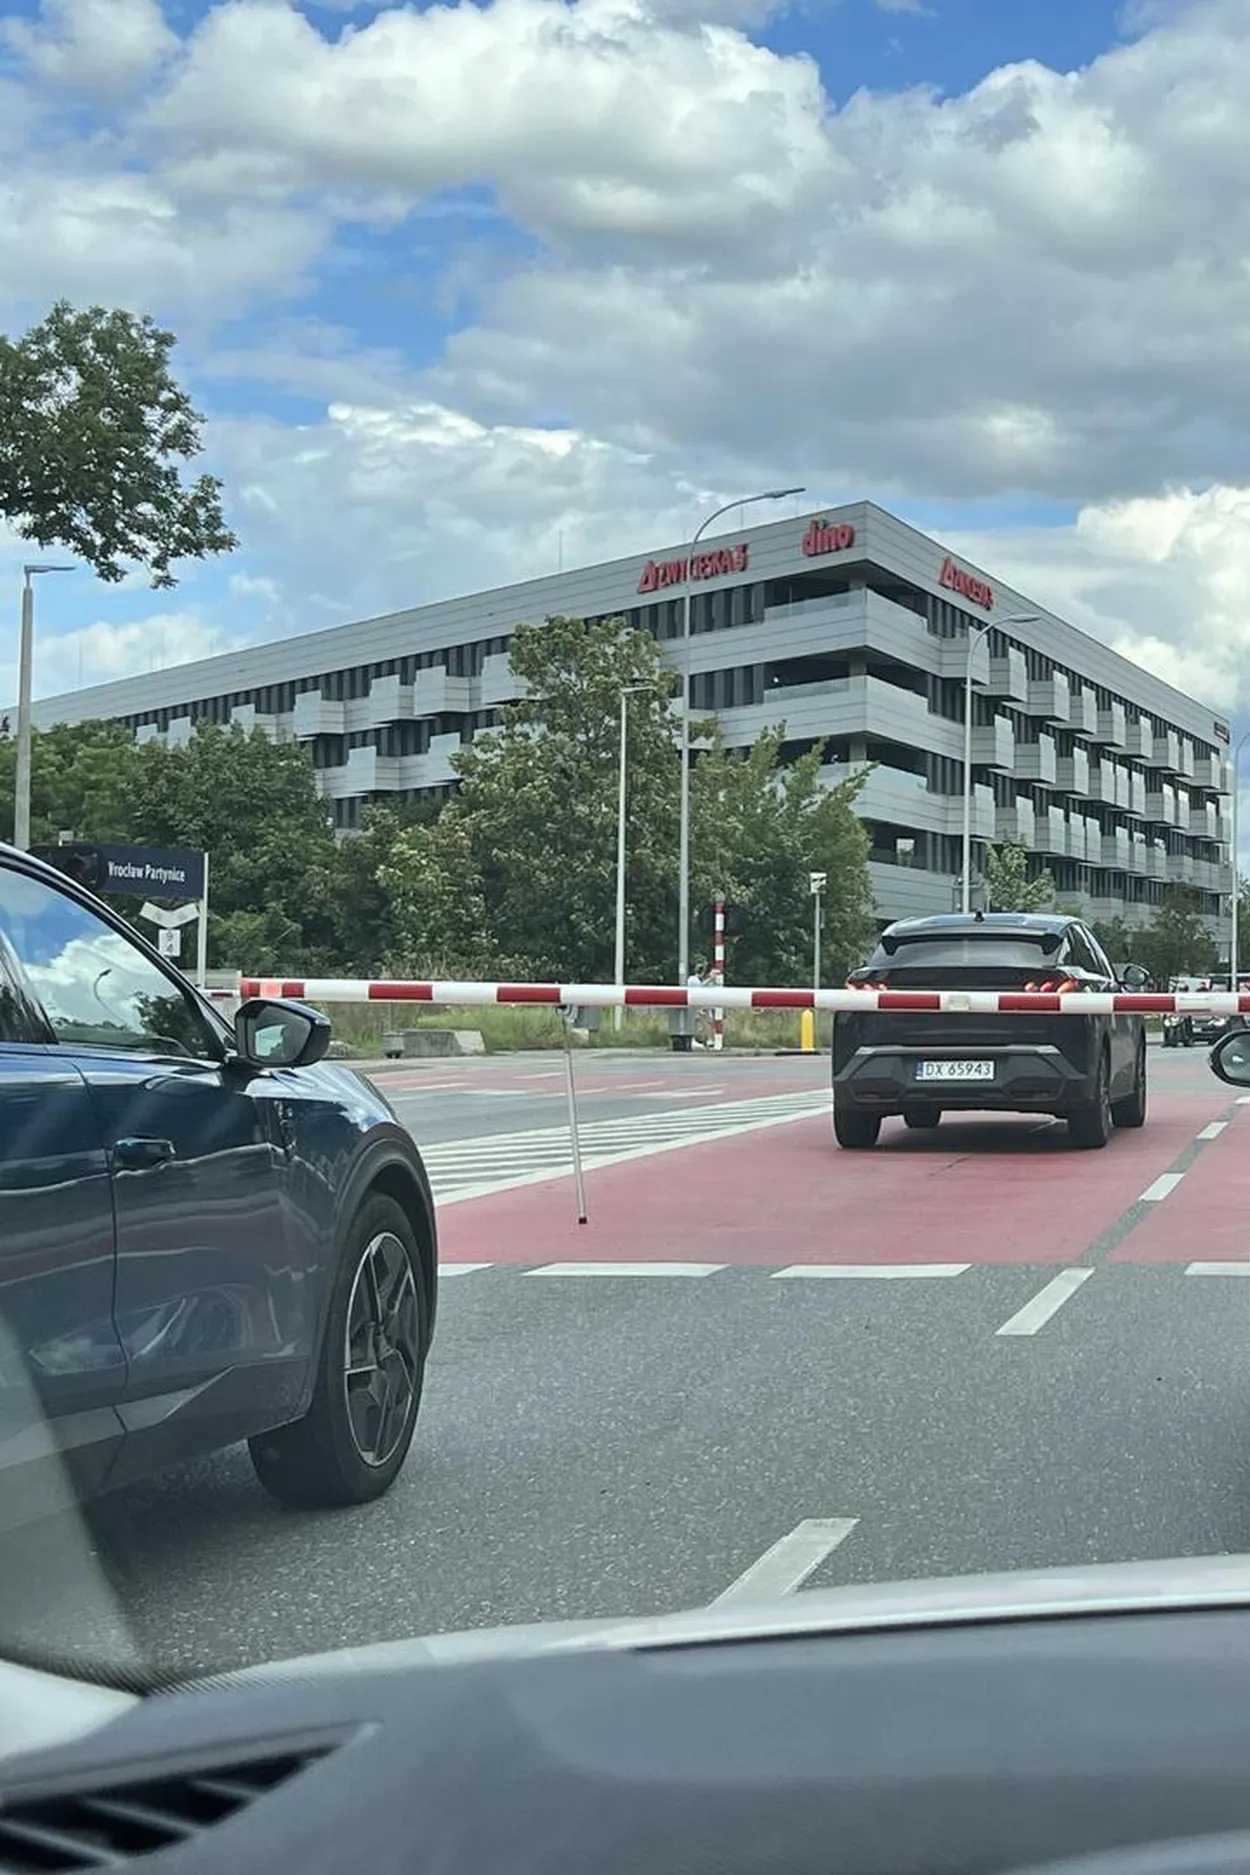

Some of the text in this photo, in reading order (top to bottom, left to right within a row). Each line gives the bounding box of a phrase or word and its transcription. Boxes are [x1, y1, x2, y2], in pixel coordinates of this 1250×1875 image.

[803, 519, 854, 556] dino
[145, 864, 185, 884] Partynice
[926, 1063, 943, 1076] DX
[948, 1063, 991, 1076] 65943
